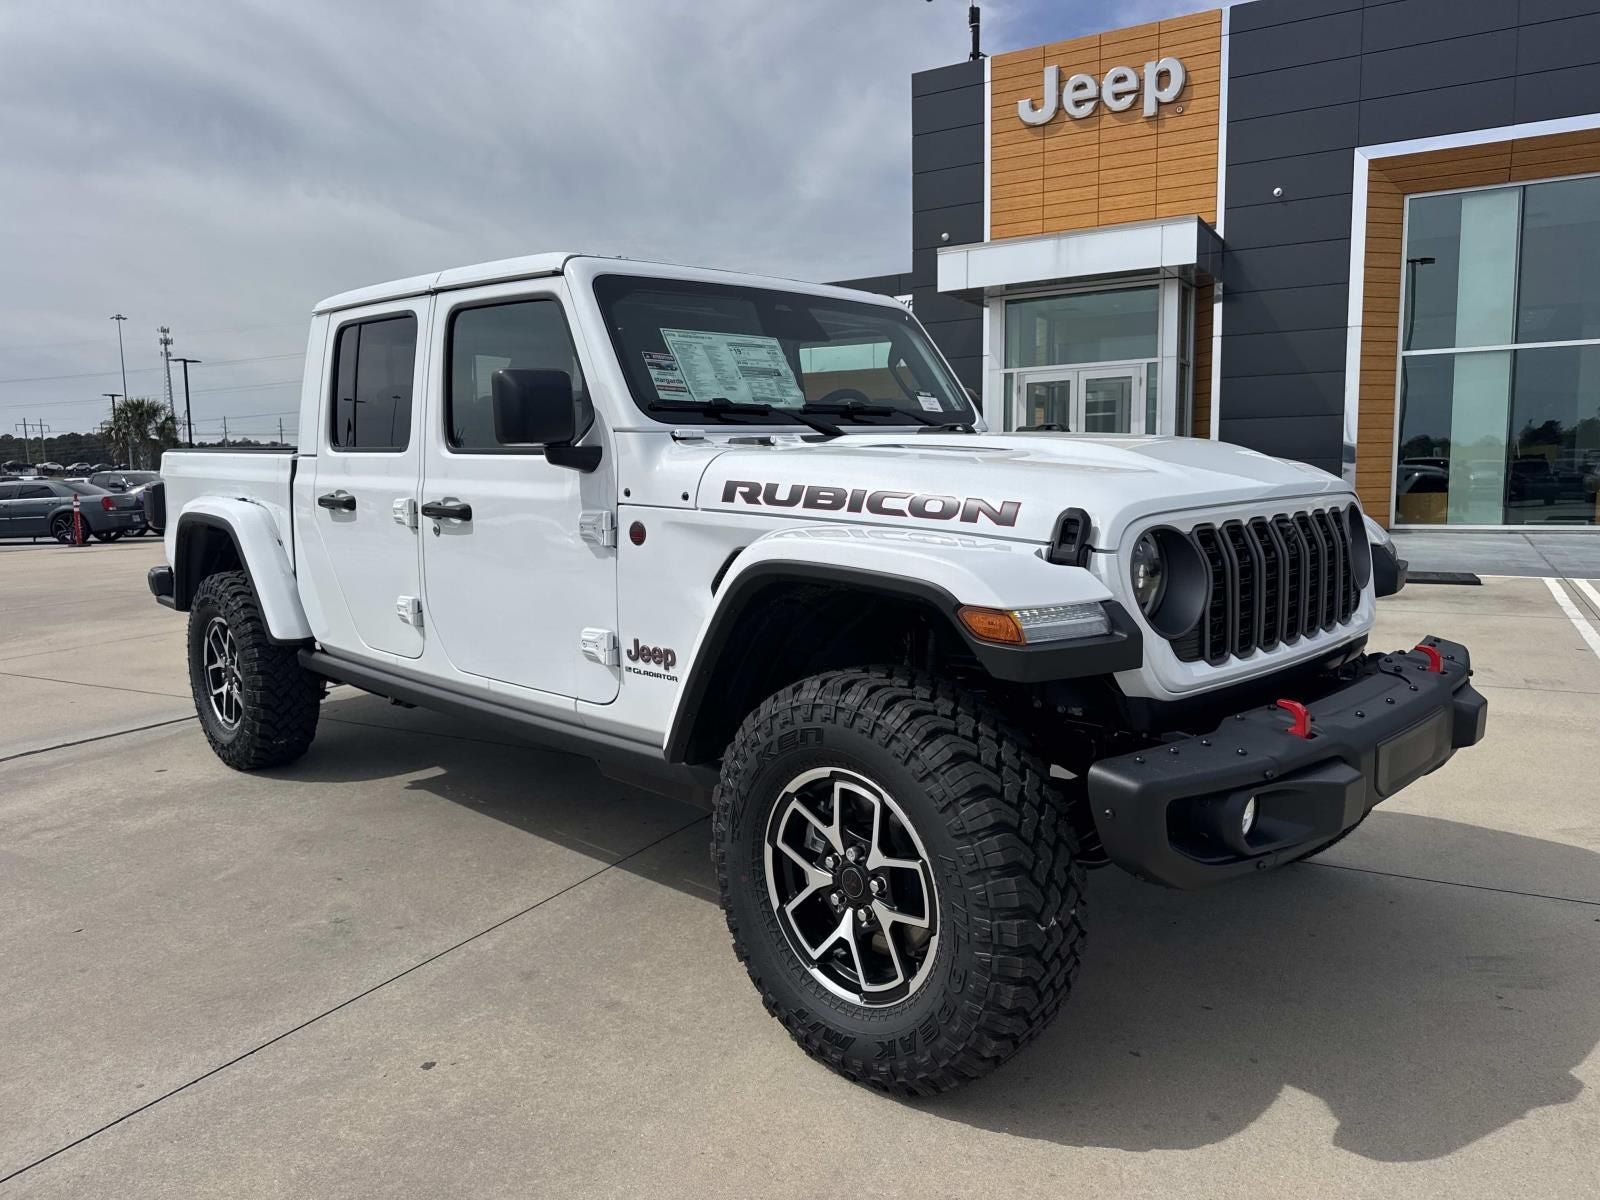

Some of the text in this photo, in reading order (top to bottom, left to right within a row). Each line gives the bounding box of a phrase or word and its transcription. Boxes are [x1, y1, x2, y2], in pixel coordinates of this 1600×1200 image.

[1017, 57, 1186, 126] Jeep
[721, 480, 1022, 527] RUBICON
[626, 638, 677, 671] Jeep
[632, 667, 679, 682] GLADIATOR
